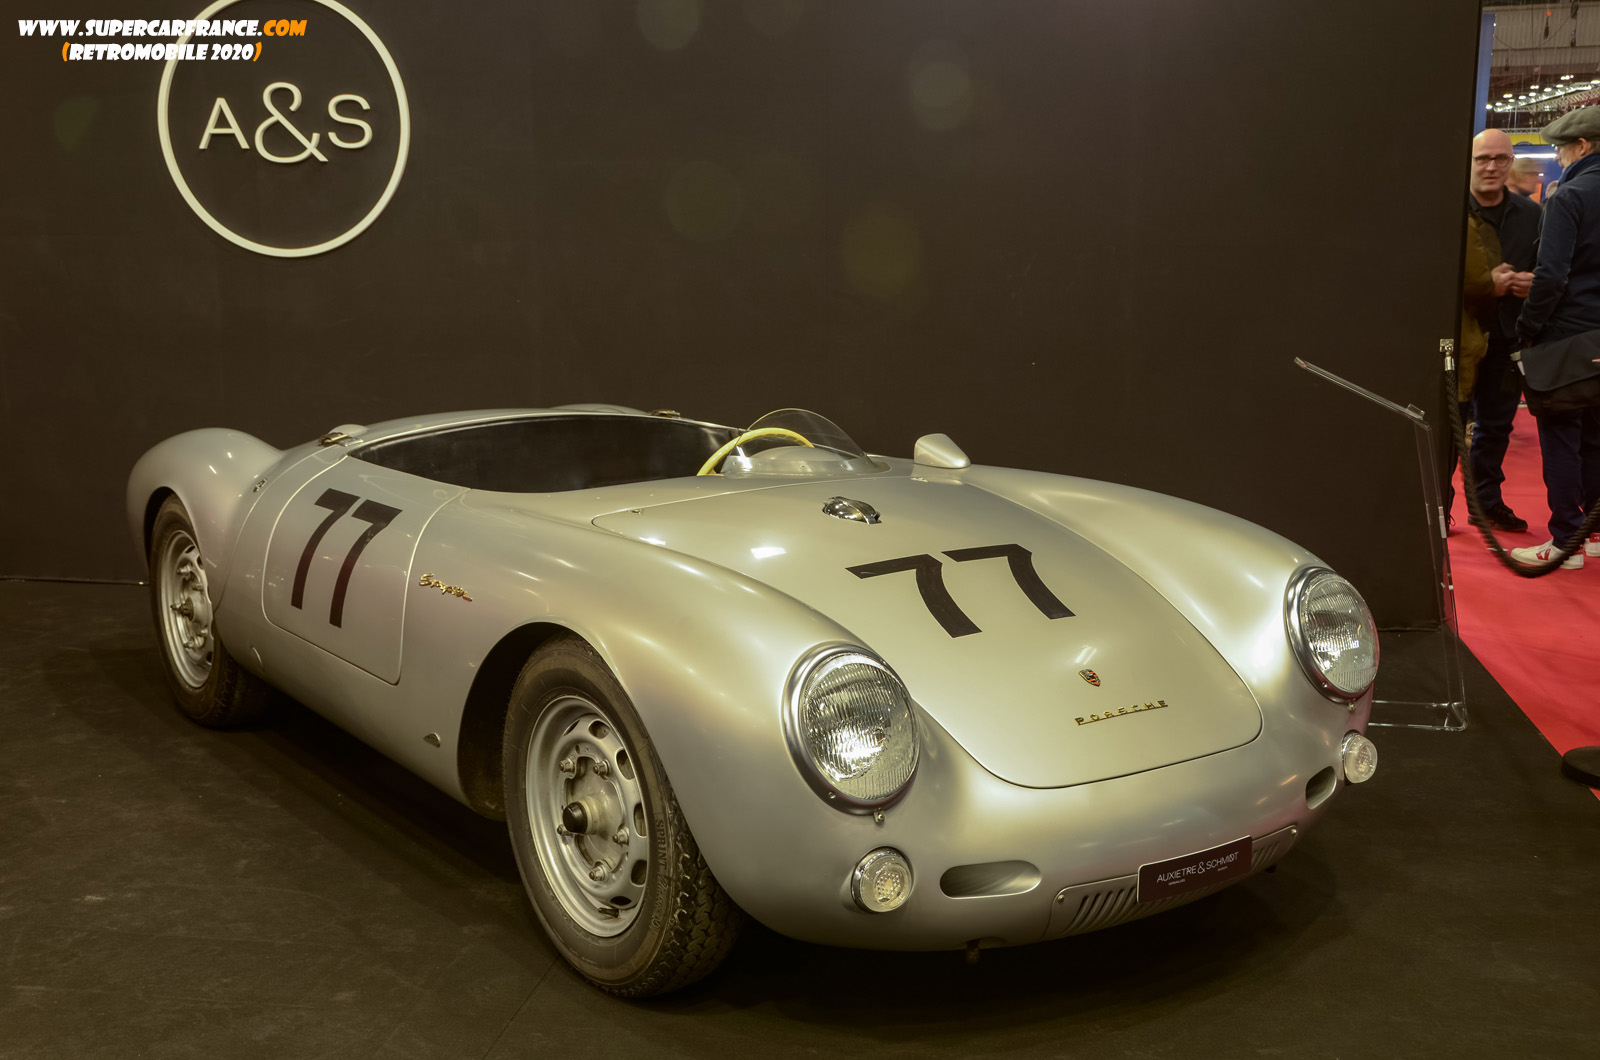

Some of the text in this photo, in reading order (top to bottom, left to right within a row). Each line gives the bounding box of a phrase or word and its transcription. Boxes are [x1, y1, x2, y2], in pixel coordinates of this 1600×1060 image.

[199, 82, 373, 163] A&S
[291, 488, 403, 629] 77
[845, 543, 1077, 638] 77
[1074, 700, 1168, 726] PORSCHE
[655, 820, 668, 870] SPRINT
[1156, 865, 1197, 883] AUXIETRE
[1206, 851, 1239, 870] SCHMIDT
